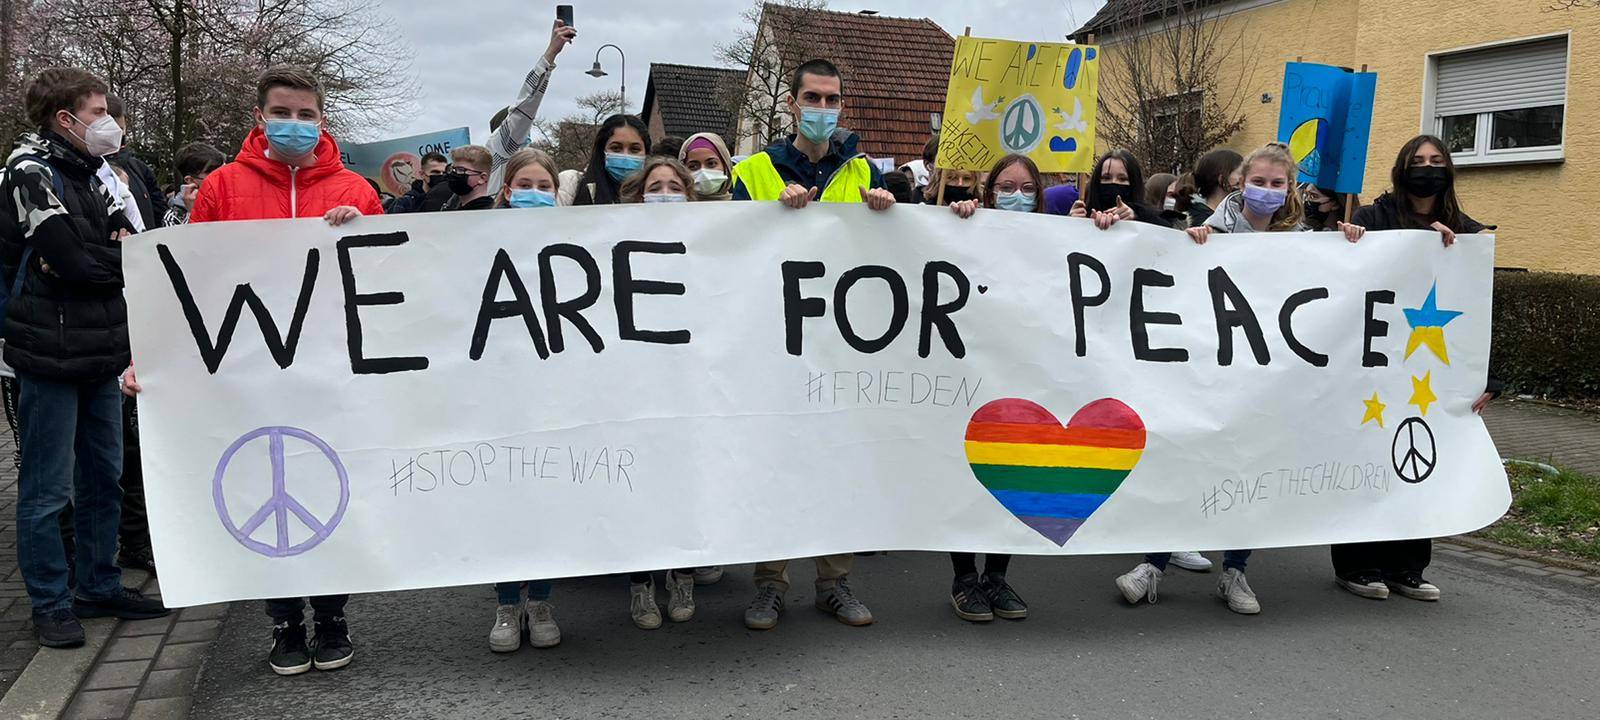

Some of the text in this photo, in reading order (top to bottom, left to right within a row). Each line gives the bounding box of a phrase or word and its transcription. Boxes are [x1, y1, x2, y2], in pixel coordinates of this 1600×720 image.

[953, 39, 1097, 96] WE ARE FOR
[418, 141, 451, 157] COME
[943, 119, 995, 169] #KEIN
[156, 231, 1396, 374] WE ARE FOR PEACE
[805, 370, 982, 407] #FRIEDEN
[569, 446, 635, 492] WAR
[1200, 471, 1273, 519] #SAVE
